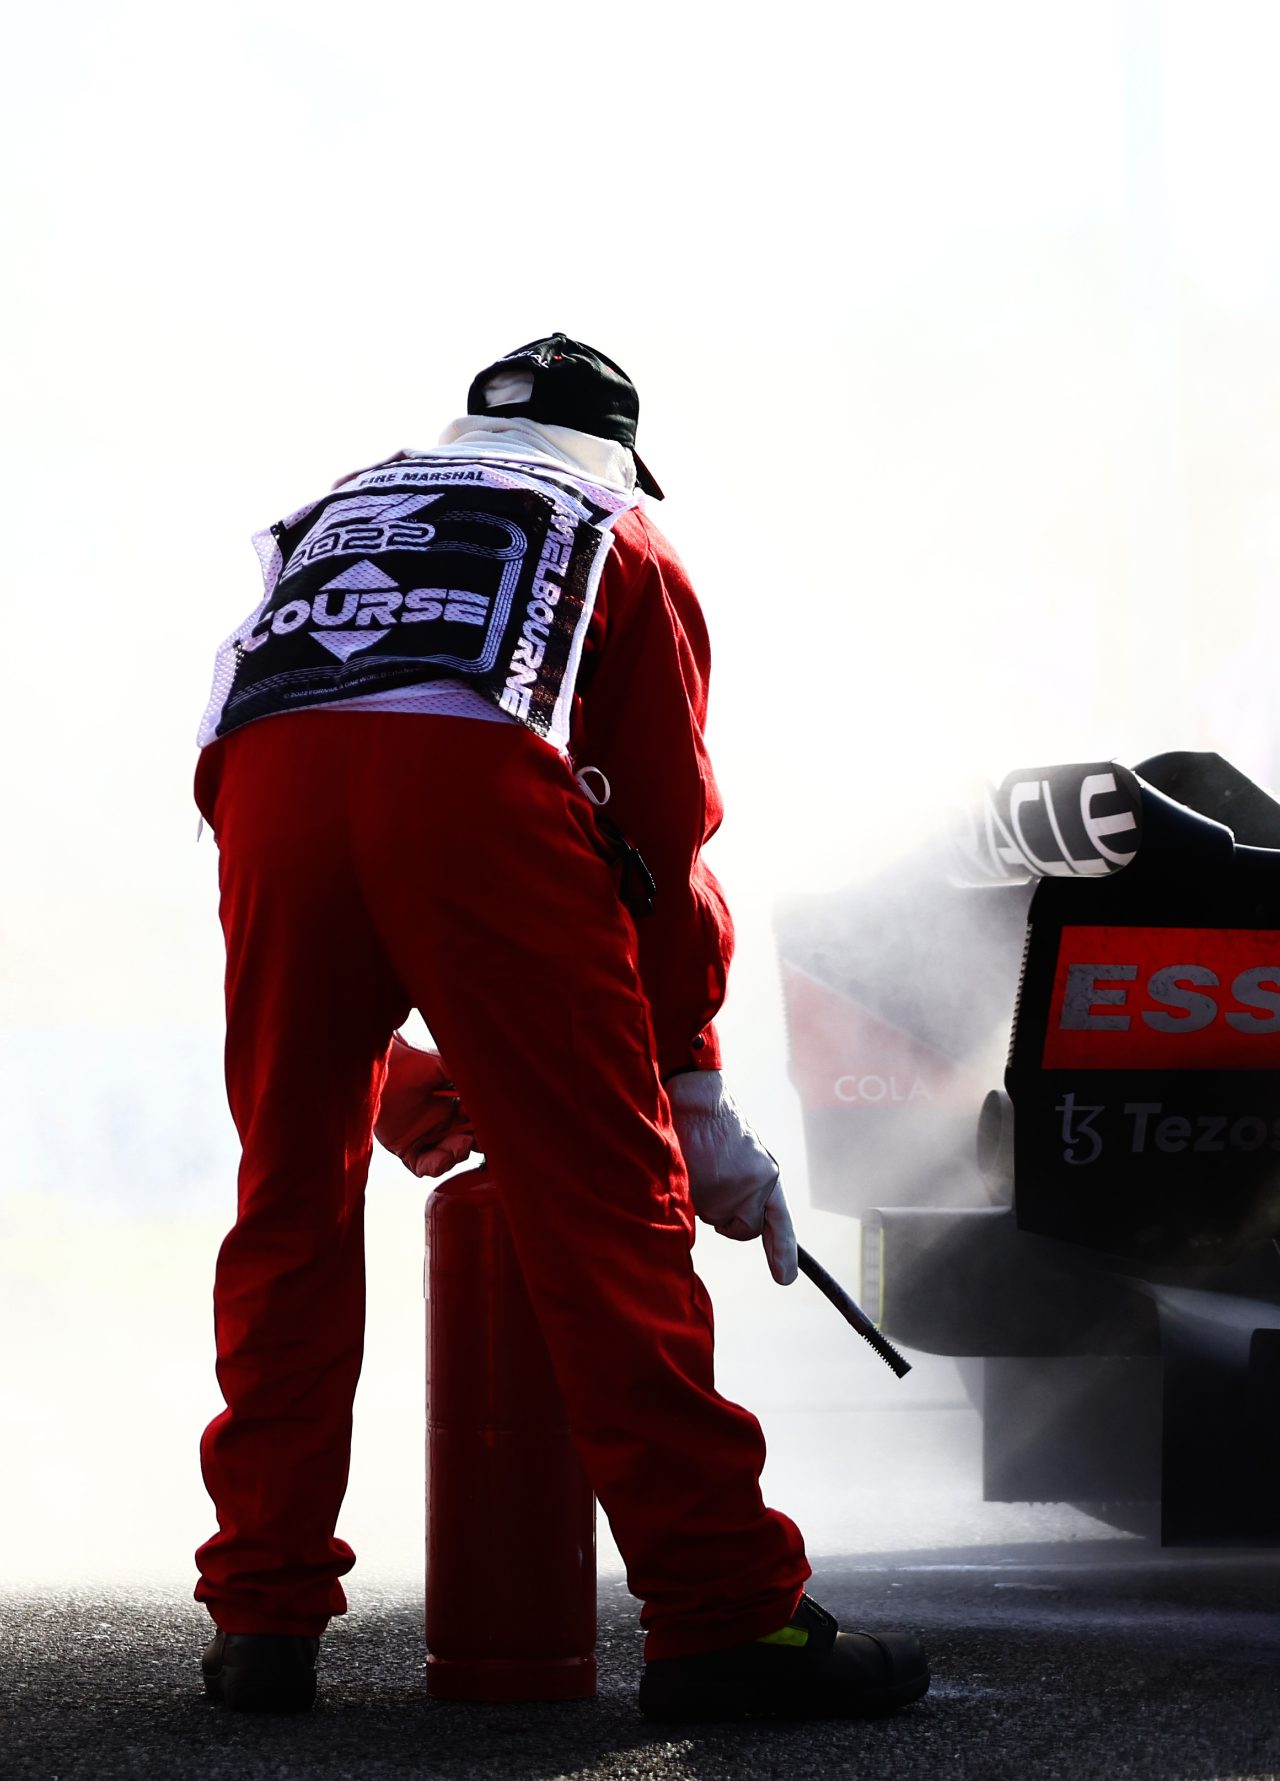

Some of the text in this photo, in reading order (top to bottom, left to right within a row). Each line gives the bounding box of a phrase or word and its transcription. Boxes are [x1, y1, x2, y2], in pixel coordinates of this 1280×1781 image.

[359, 470, 484, 487] FIRE MARSHAL
[279, 520, 437, 585] 2022
[243, 588, 490, 652] COURSE
[499, 501, 580, 720] MELBOURNE
[1059, 963, 1280, 1034] ESS
[834, 1075, 932, 1102] COLA
